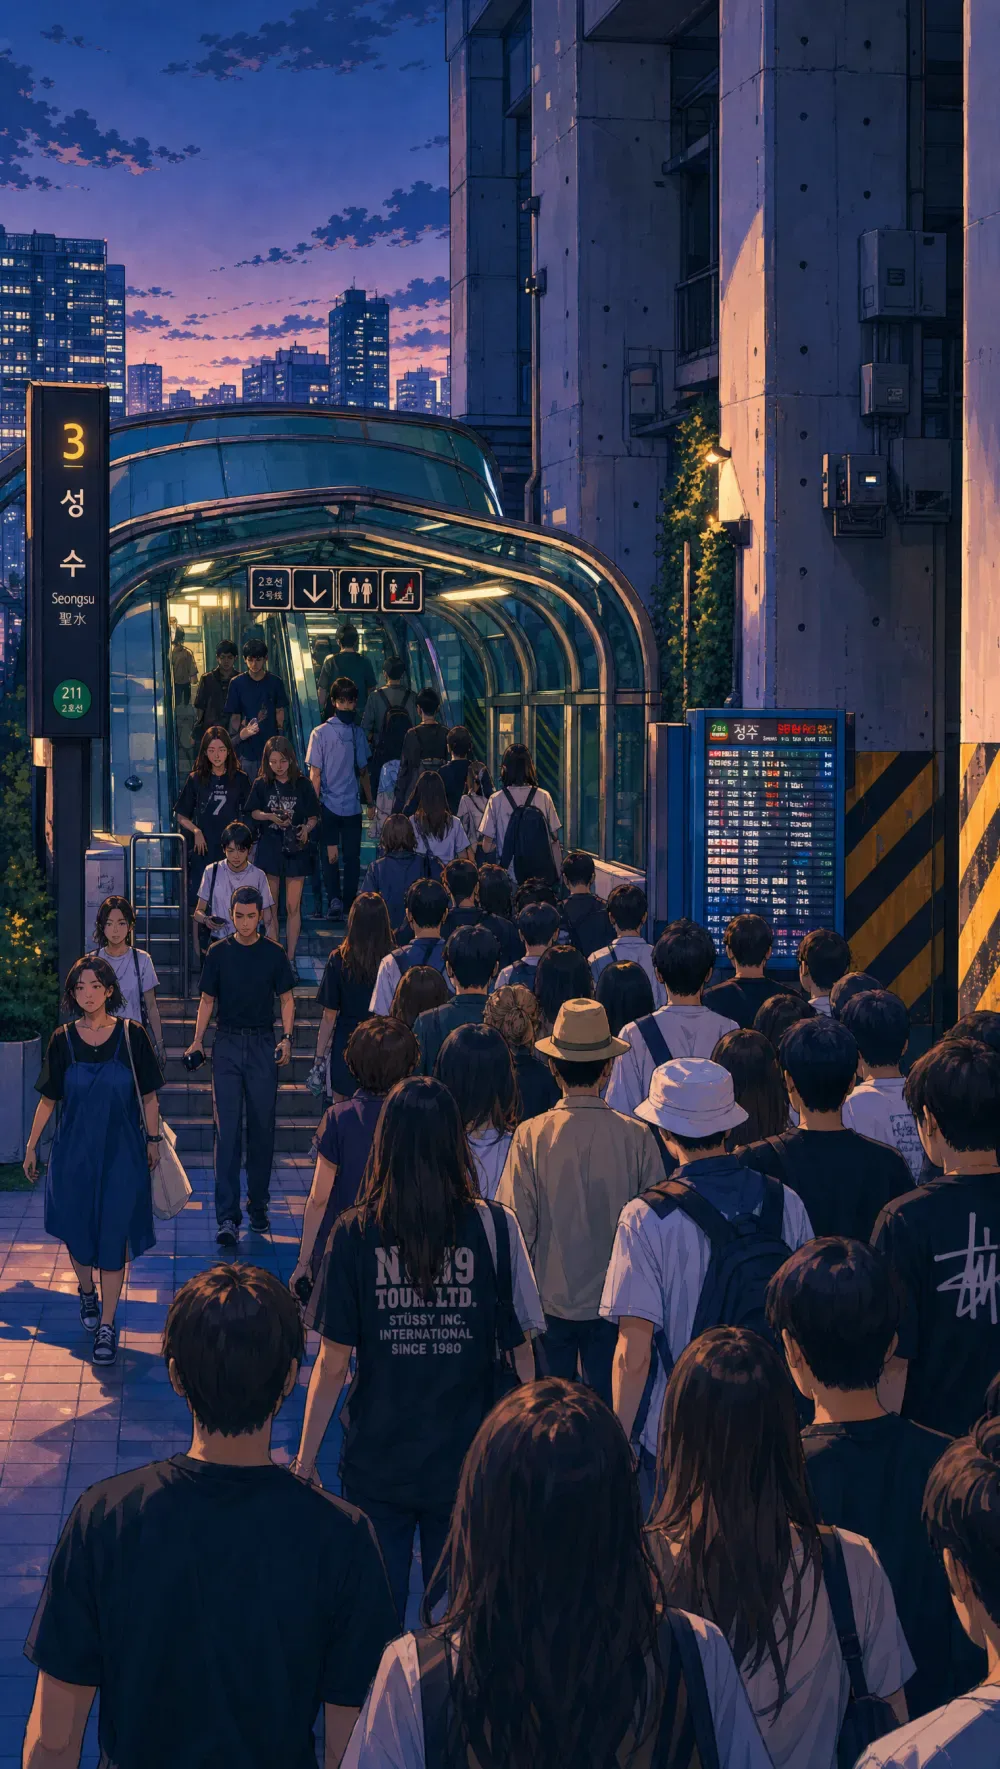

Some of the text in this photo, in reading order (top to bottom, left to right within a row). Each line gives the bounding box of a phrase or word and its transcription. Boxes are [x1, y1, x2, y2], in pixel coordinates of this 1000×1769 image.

[63, 422, 85, 460] 3
[258, 576, 283, 588] 2호선
[51, 592, 95, 608] Seongsu
[58, 611, 87, 626] 聖水
[61, 686, 81, 699] 211
[61, 703, 83, 713] 2호선
[213, 795, 227, 815] 7
[389, 1312, 466, 1326] STÜSSY INC.
[380, 1328, 474, 1341] INTERNATIONAL
[391, 1342, 462, 1355] SINCE 1980
